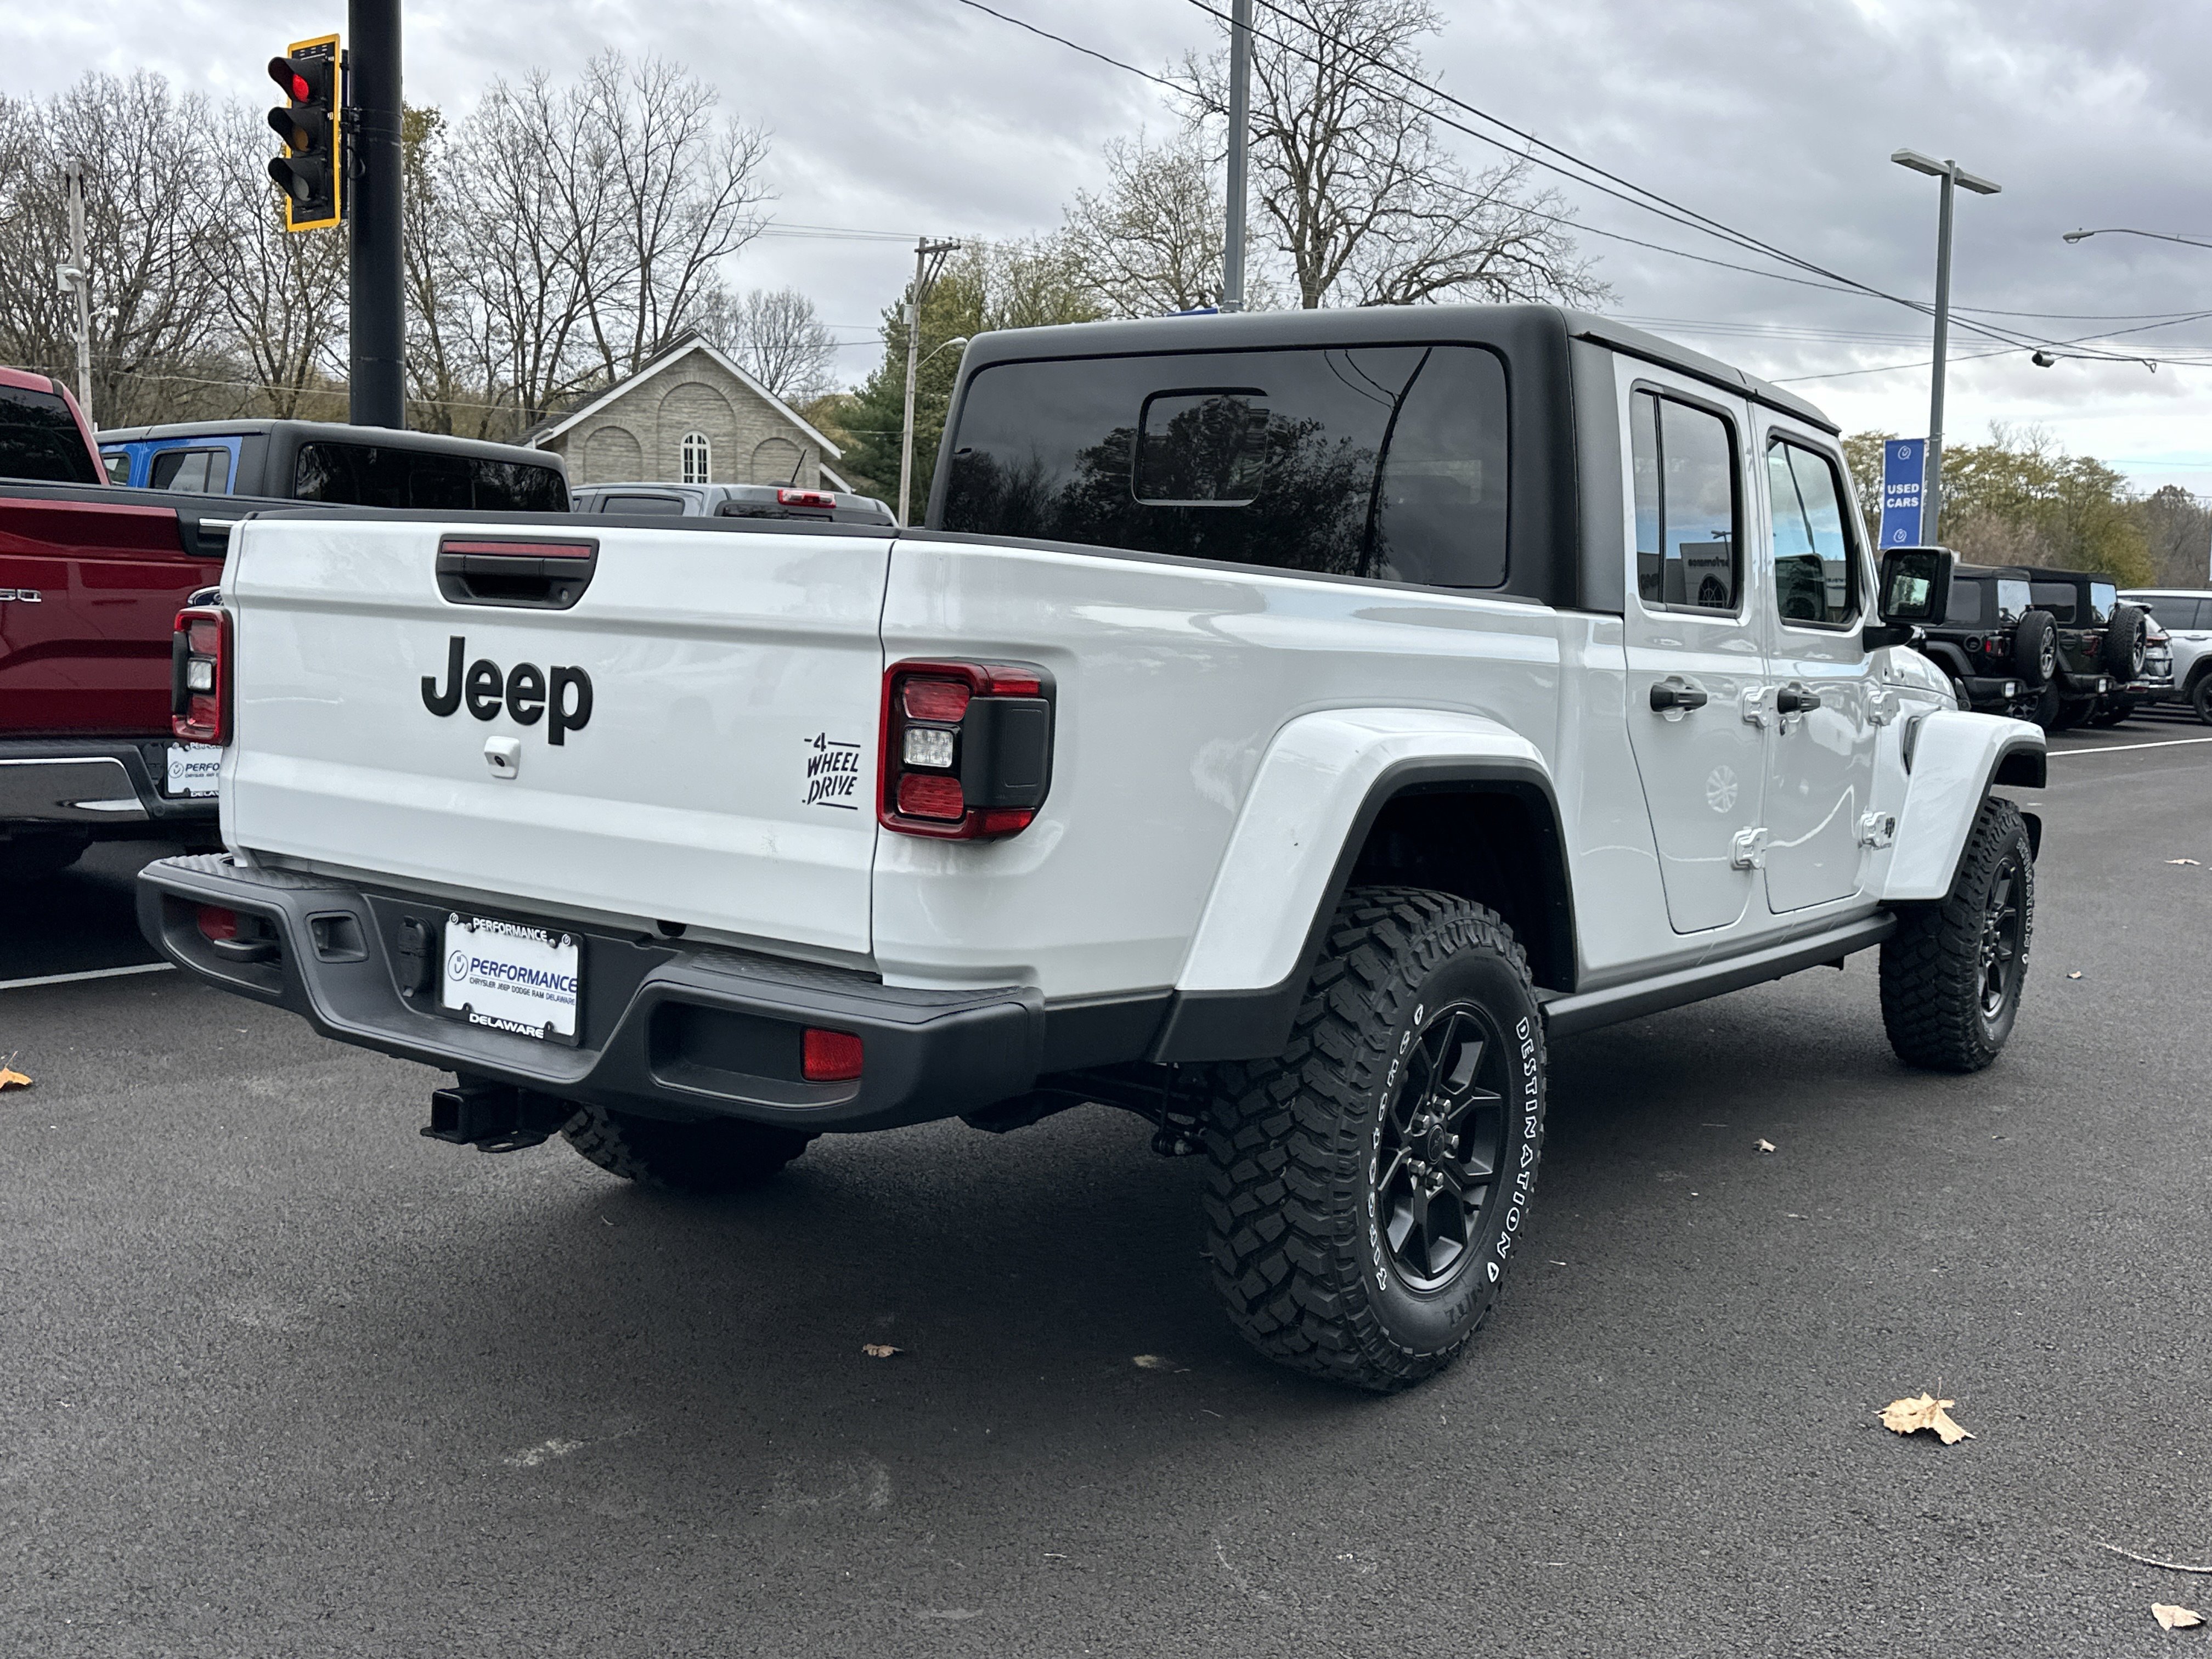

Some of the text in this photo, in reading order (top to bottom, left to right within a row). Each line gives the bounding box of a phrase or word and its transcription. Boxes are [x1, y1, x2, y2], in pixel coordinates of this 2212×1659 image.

[1887, 483, 1920, 494] USED
[1887, 496, 1919, 508] CARS
[421, 635, 593, 746] Jeep
[813, 732, 826, 752] 4
[807, 752, 859, 778] WHEEL
[806, 775, 858, 805] DRIVE
[472, 917, 548, 942] PERFORMANCE
[470, 957, 577, 993] PERFORMANCE
[469, 977, 575, 1006] CHRYSLER JEEP DODGE RAM DELAWARE
[469, 1013, 544, 1039] DELAWARE
[1497, 1017, 1537, 1259] DESTINATION
